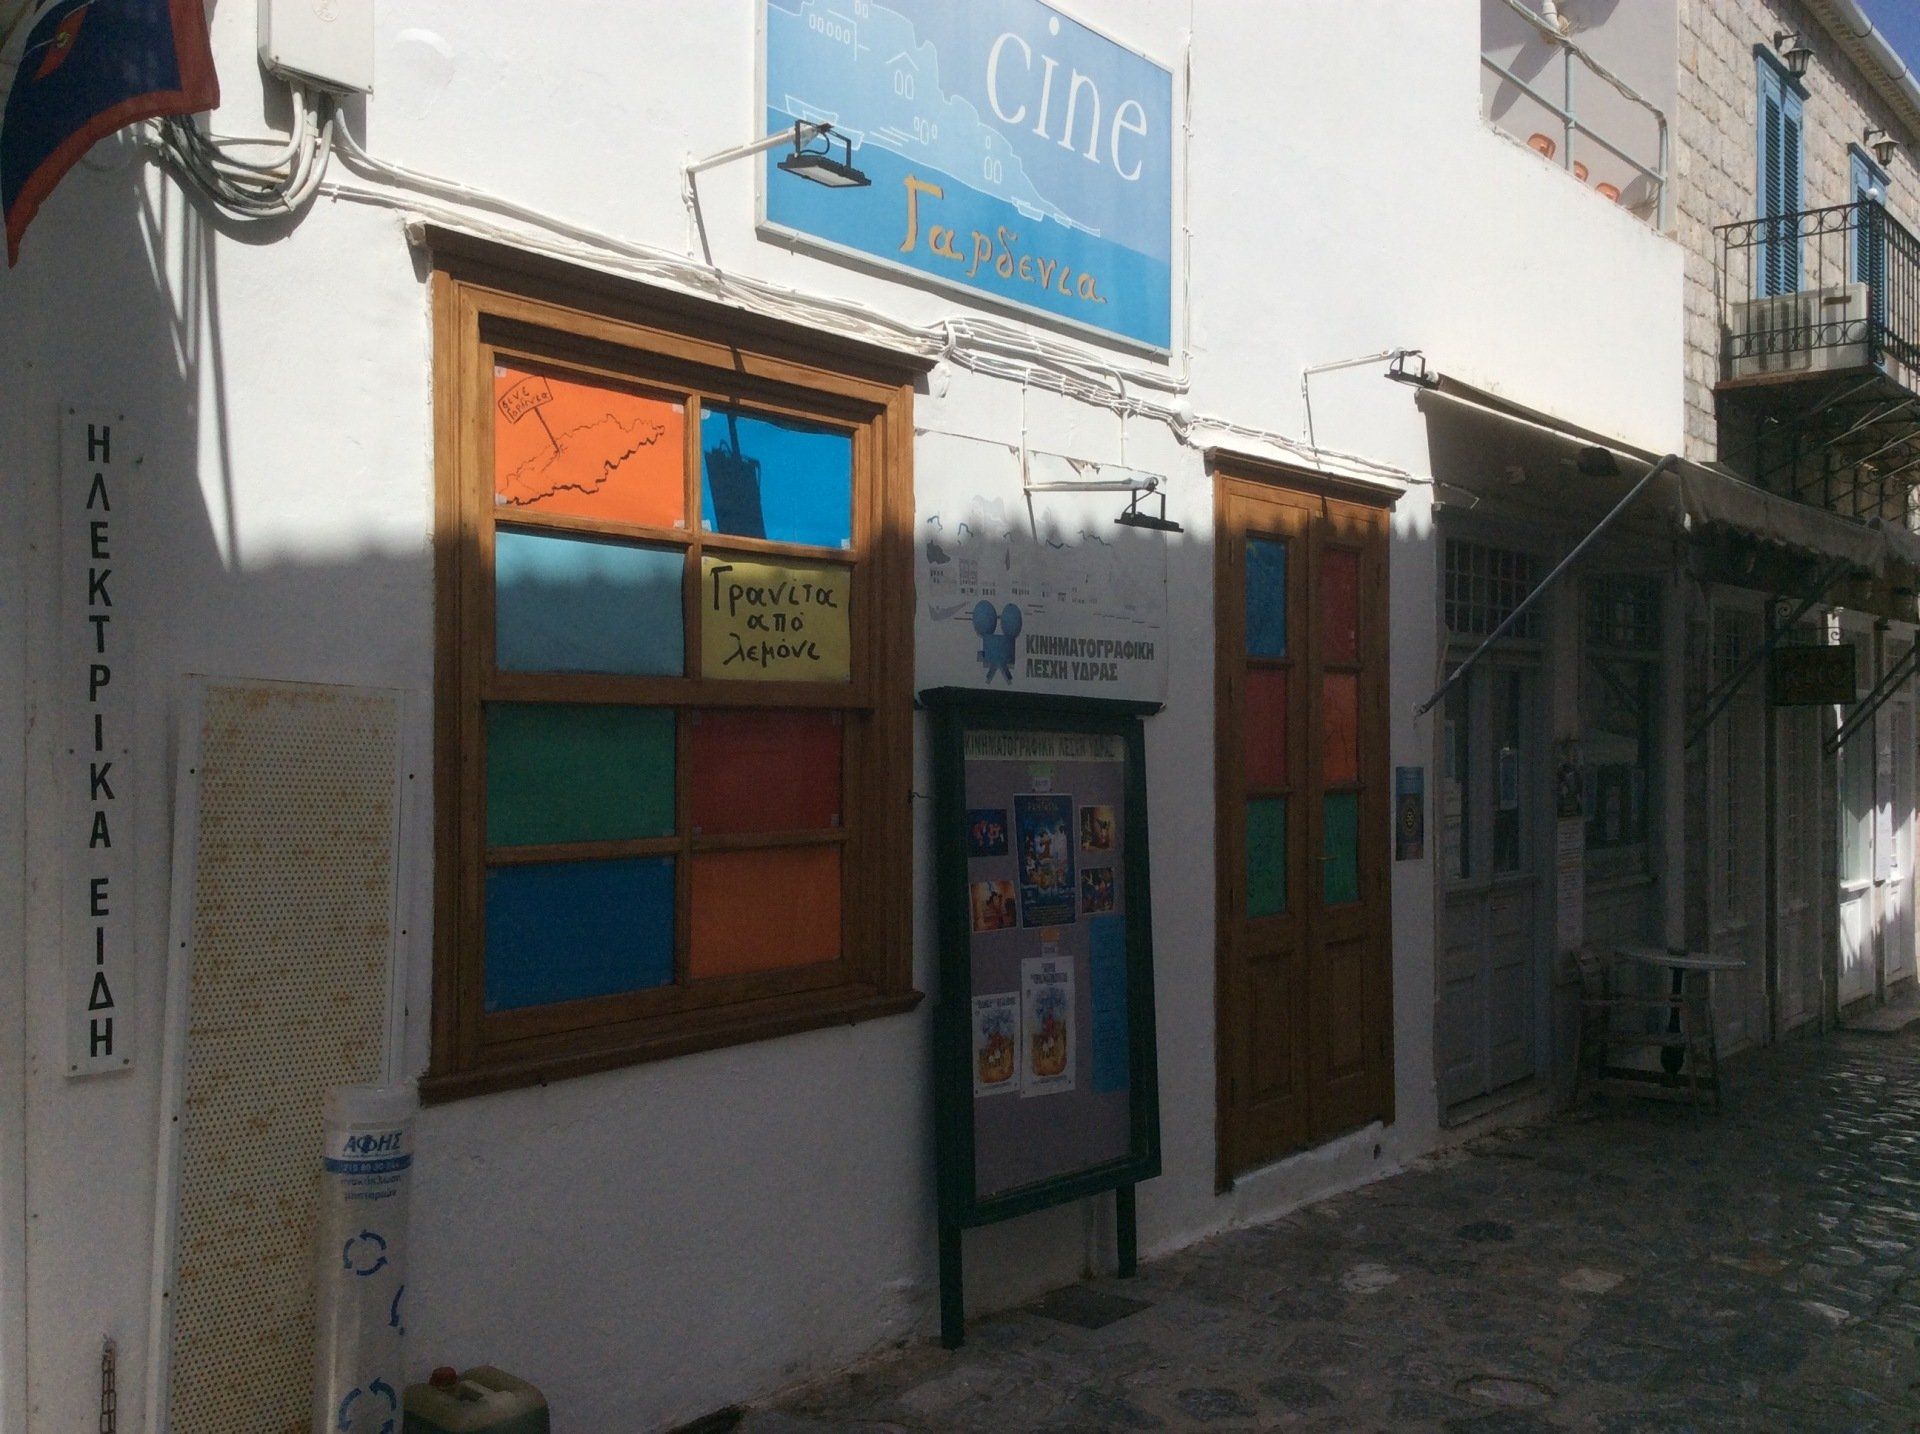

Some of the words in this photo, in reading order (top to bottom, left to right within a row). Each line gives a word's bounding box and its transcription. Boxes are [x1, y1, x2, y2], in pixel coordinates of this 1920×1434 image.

[986, 16, 1147, 181] cine
[86, 423, 115, 849] ΗΛΕΚΤΡΙΚΑ
[1025, 634, 1155, 660] ΚΙΝΗΜΑΤΟΓΡΑΦΙΚΗ
[1025, 658, 1068, 680] ΛΕΣΧΗ
[1072, 661, 1118, 681] ΥΔΡΑΣ
[88, 878, 115, 1057] ΕΙΔΗ
[343, 1131, 402, 1154] ΑΦΗΣ
